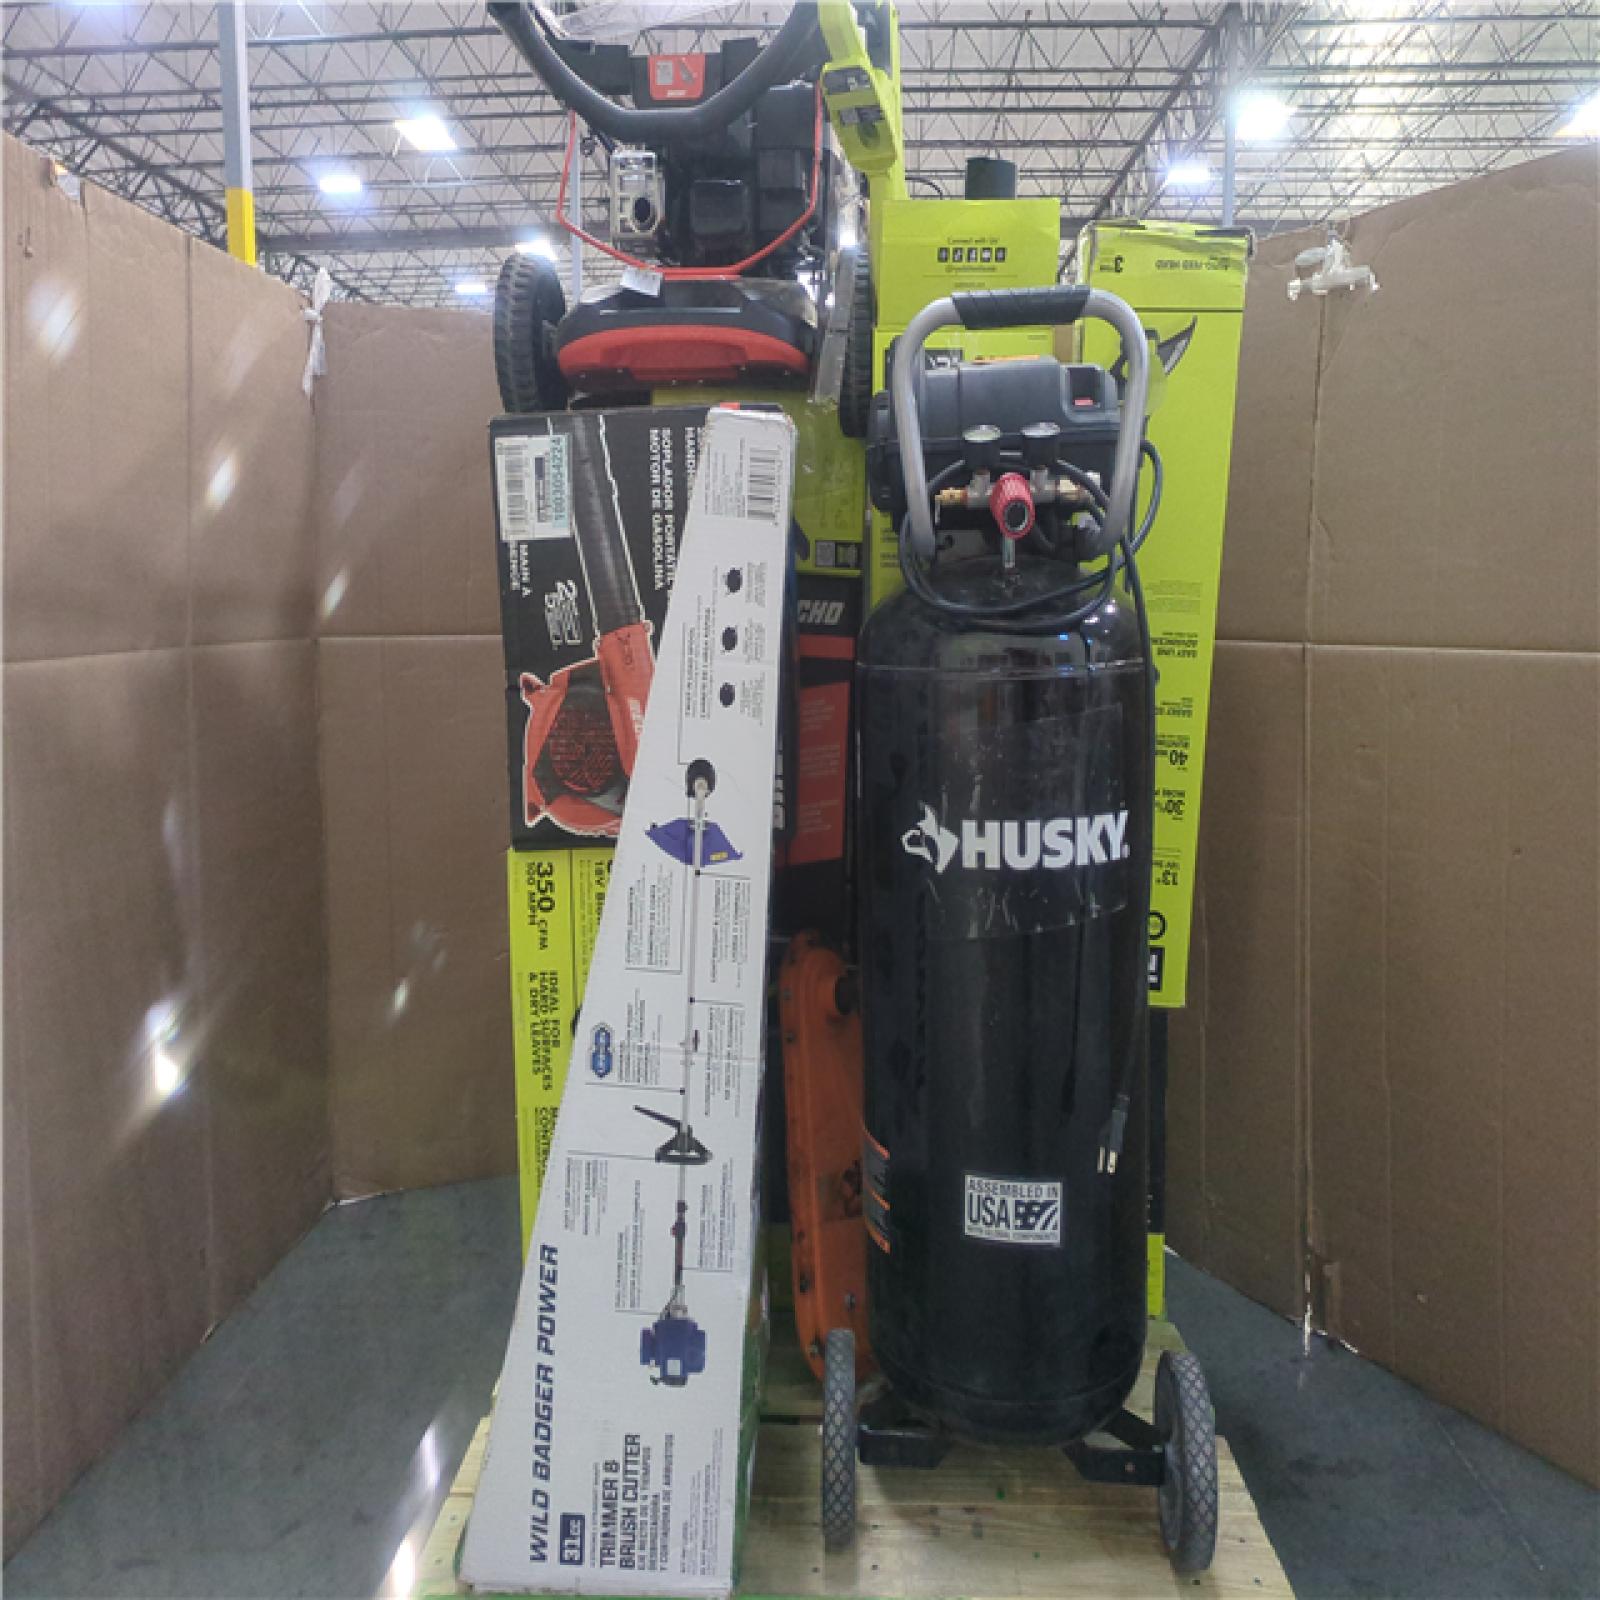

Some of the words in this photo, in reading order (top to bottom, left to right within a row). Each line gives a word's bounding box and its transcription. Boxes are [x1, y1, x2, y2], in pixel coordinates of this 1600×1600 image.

[1114, 256, 1124, 273] 3
[649, 429, 661, 484] MOTOR
[661, 428, 674, 511] SOPLADOR
[651, 488, 662, 510] DE
[652, 513, 665, 591] GASOLINA
[798, 599, 845, 625] CHO
[1169, 749, 1188, 766] 40
[961, 809, 1129, 871] HUSKY
[527, 861, 536, 886] 100
[536, 861, 556, 913] 350
[527, 890, 538, 926] MPH
[537, 918, 548, 951] CFM
[528, 971, 538, 983] &
[538, 970, 549, 1017] HARD
[549, 970, 560, 1015] IDEAL
[529, 987, 540, 1017] DRY
[530, 1021, 542, 1076] LEAVES
[540, 1018, 553, 1091] SURFACES
[550, 1018, 561, 1049] FOR
[968, 1178, 1043, 1199] ASSEMBLED
[1046, 1185, 1059, 1199] IN
[968, 1191, 1011, 1230] USA
[536, 1243, 558, 1356] POWER
[532, 1363, 554, 1482] BADGER
[622, 1434, 640, 1502] CUTTER
[529, 1489, 549, 1563] WILD
[600, 1479, 618, 1569] TRIMMER
[620, 1506, 636, 1570] BRUSH
